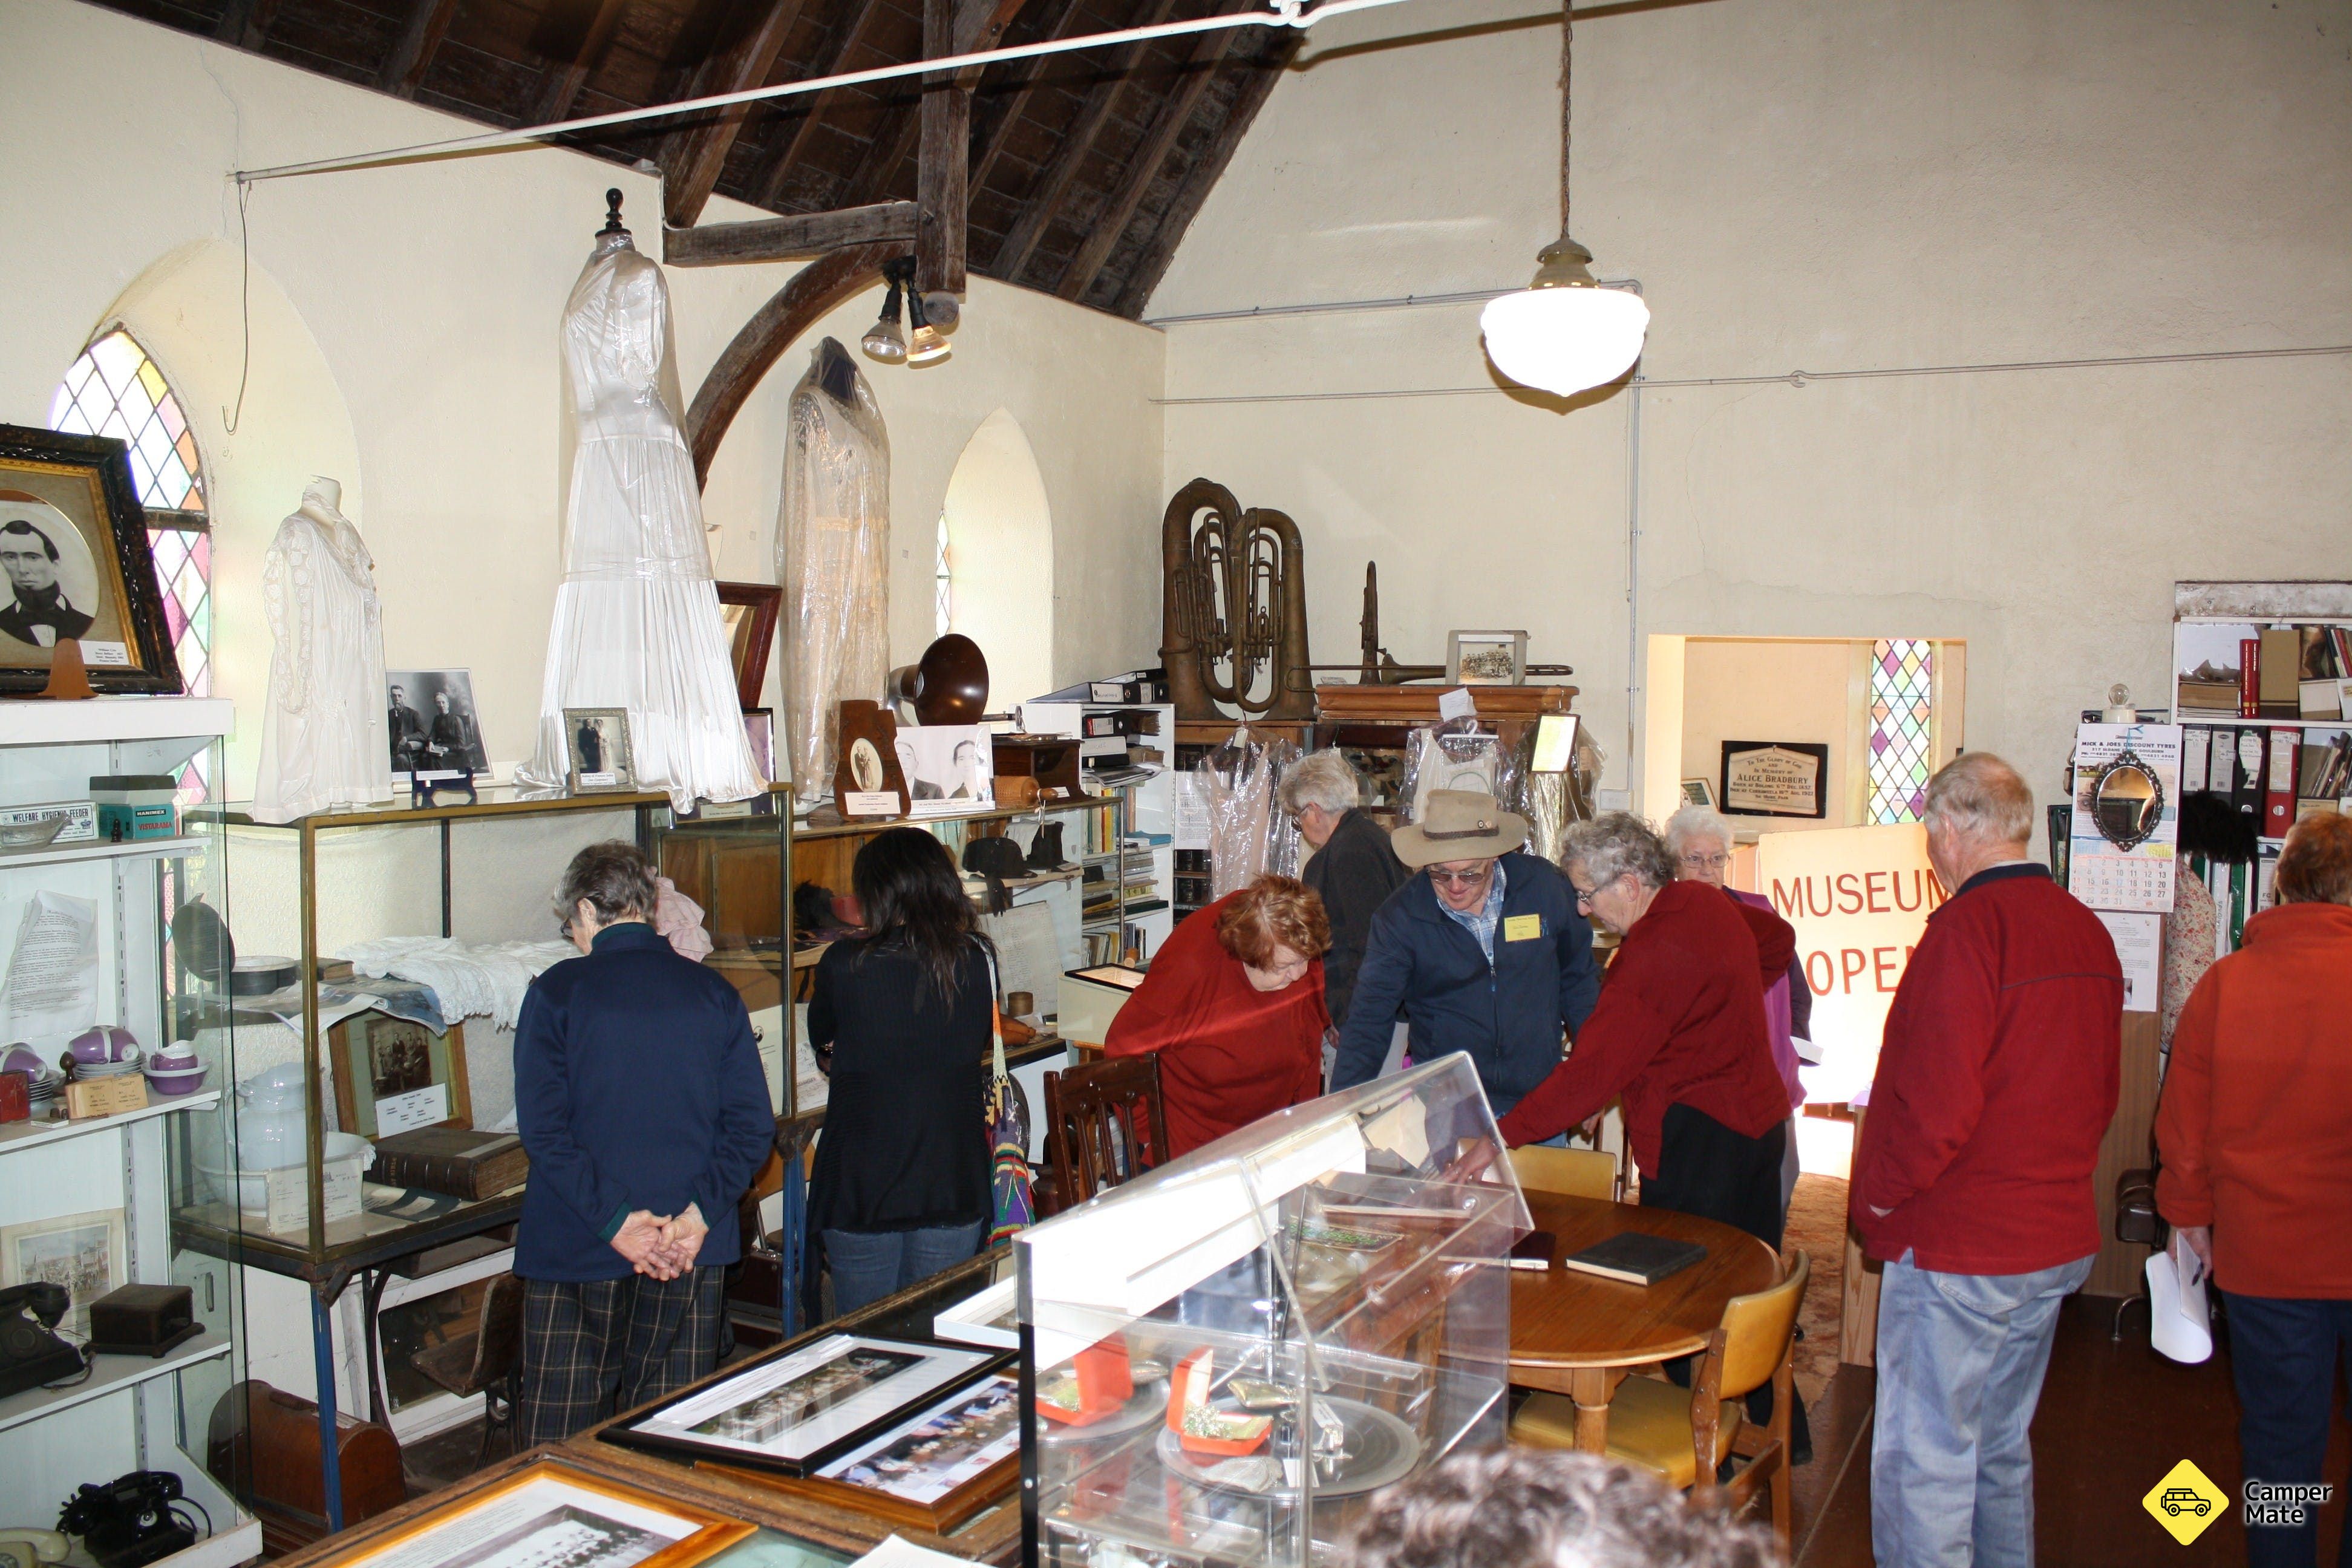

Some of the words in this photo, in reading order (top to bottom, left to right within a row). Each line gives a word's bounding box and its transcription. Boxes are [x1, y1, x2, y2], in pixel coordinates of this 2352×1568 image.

[1737, 774, 1762, 782] ALICE
[1765, 774, 1809, 785] BRADBURY
[12, 812, 39, 823] WELFARE
[70, 808, 88, 818] FEEDER
[1772, 869, 1949, 918] MUSEUM
[1806, 946, 1916, 996] OPE
